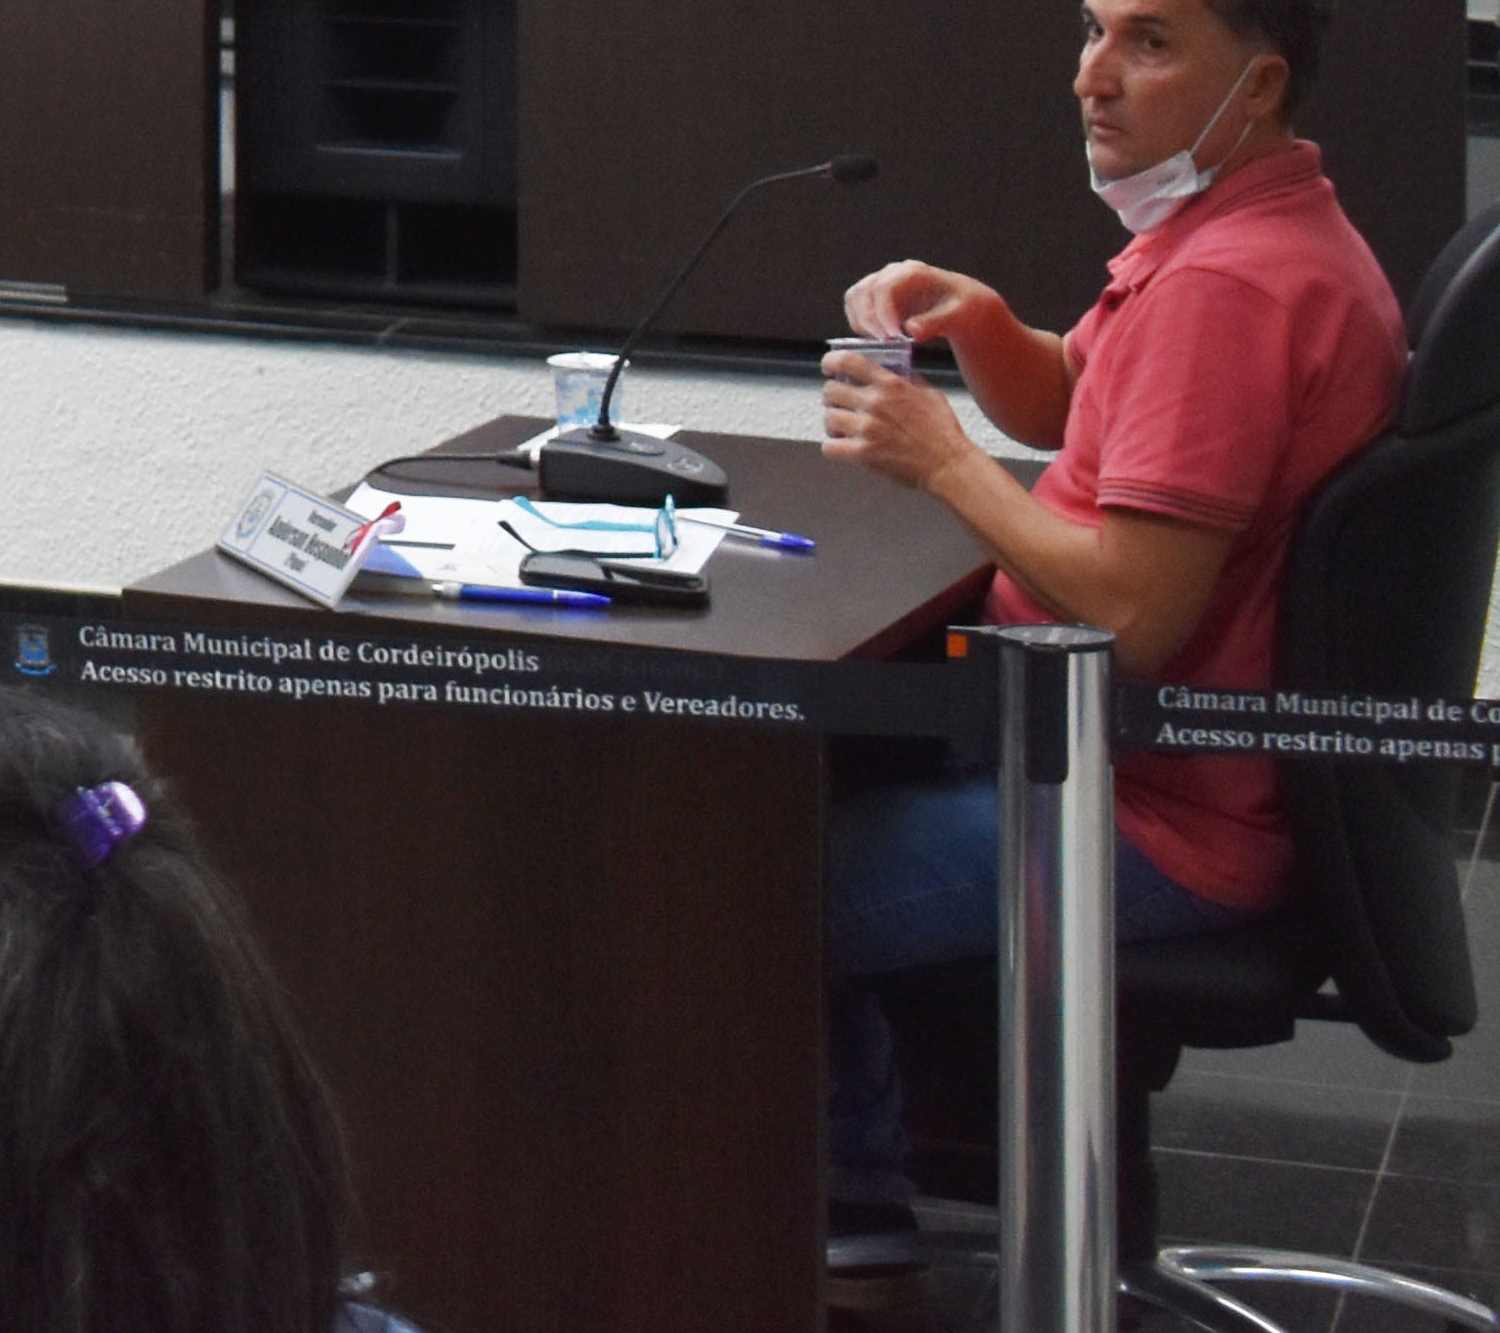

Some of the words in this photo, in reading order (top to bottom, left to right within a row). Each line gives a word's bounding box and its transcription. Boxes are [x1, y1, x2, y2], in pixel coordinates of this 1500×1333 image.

[79, 625, 176, 654] Câmara
[184, 632, 312, 665] Municipal
[319, 639, 351, 662] de
[357, 641, 541, 674] Cordeirópolis
[80, 660, 168, 684] Acesso
[174, 669, 273, 693] restrito
[279, 674, 372, 700] apenas
[378, 681, 438, 705] para
[444, 680, 614, 711] funcionários
[621, 695, 637, 712] e
[643, 690, 806, 722] Vereadores.
[1157, 685, 1267, 714] Câmara
[1275, 692, 1420, 729] Municipal
[1426, 698, 1463, 723] de
[1156, 722, 1255, 748] Acesso
[1263, 729, 1372, 755] restrito
[1379, 737, 1485, 763] apenas
